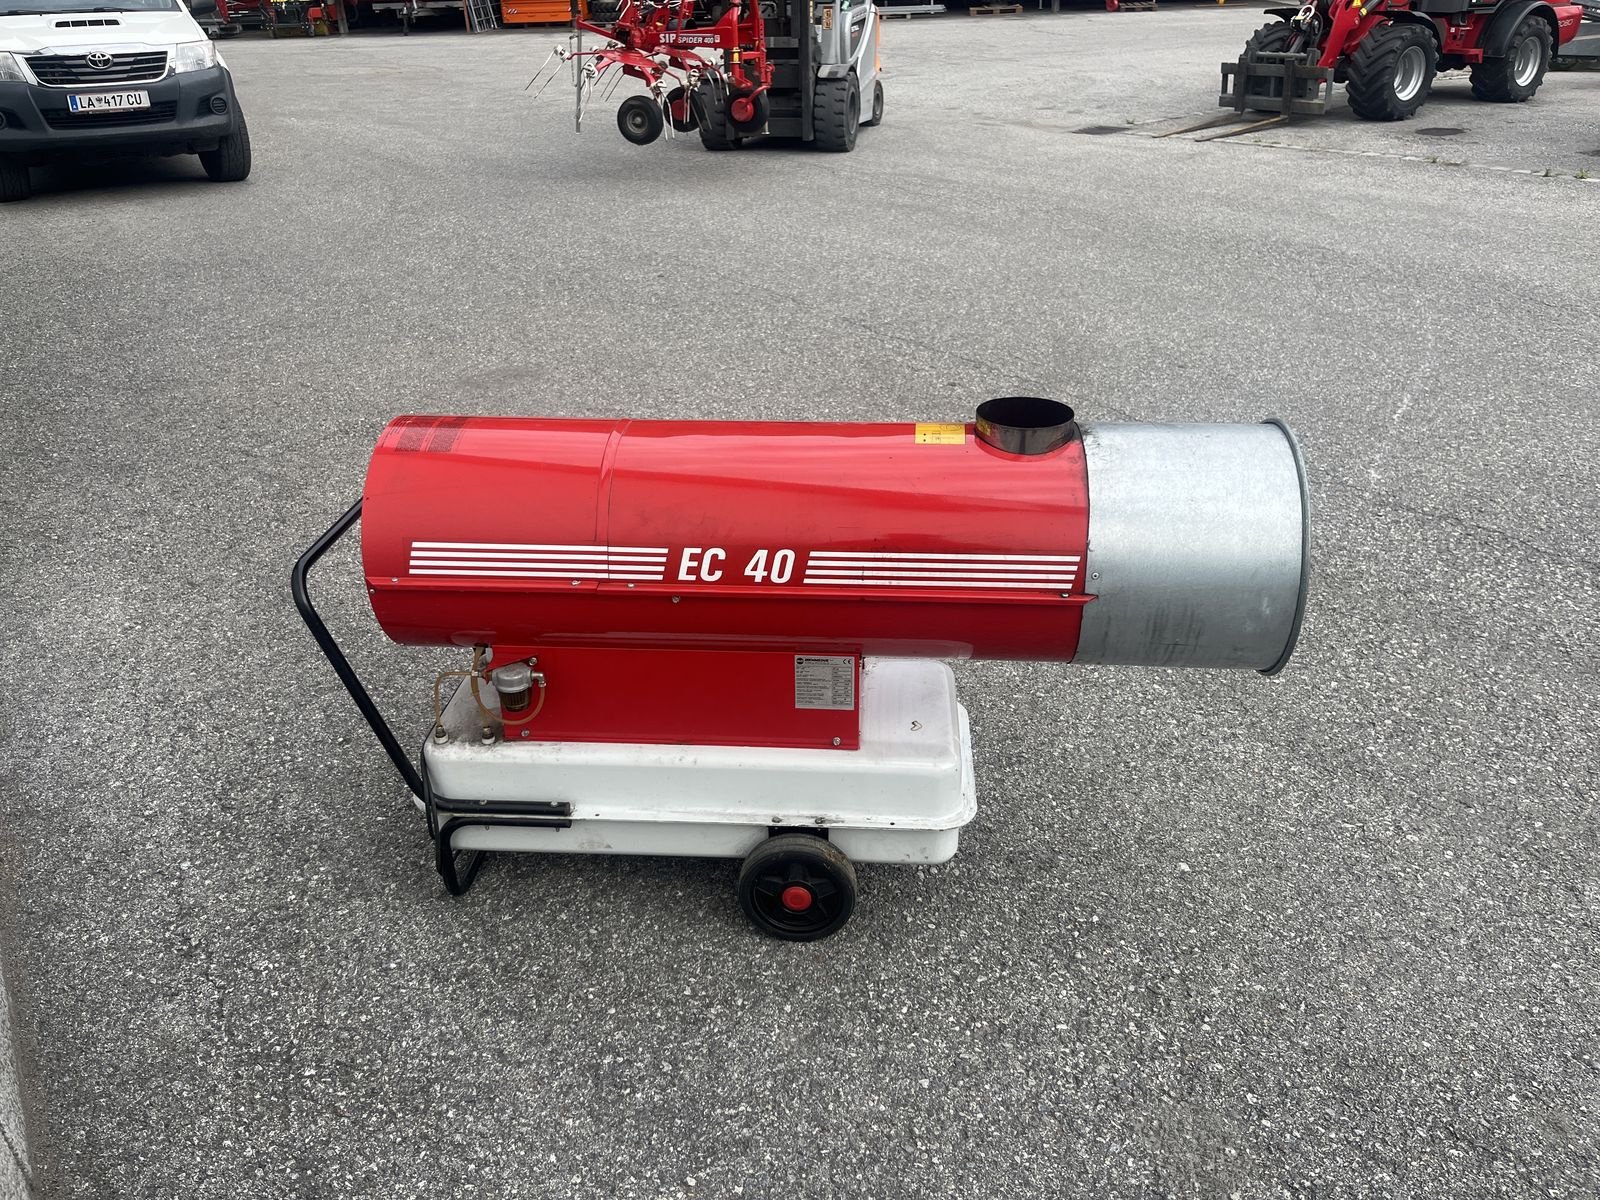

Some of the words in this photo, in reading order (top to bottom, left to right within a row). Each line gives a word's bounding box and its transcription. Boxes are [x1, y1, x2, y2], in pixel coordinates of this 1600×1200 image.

[659, 34, 676, 43] SIP
[678, 36, 702, 44] SPIDER
[79, 97, 96, 109] LA
[104, 95, 123, 107] 417
[126, 94, 142, 106] CU
[678, 547, 726, 582] EC
[743, 548, 796, 584] 40
